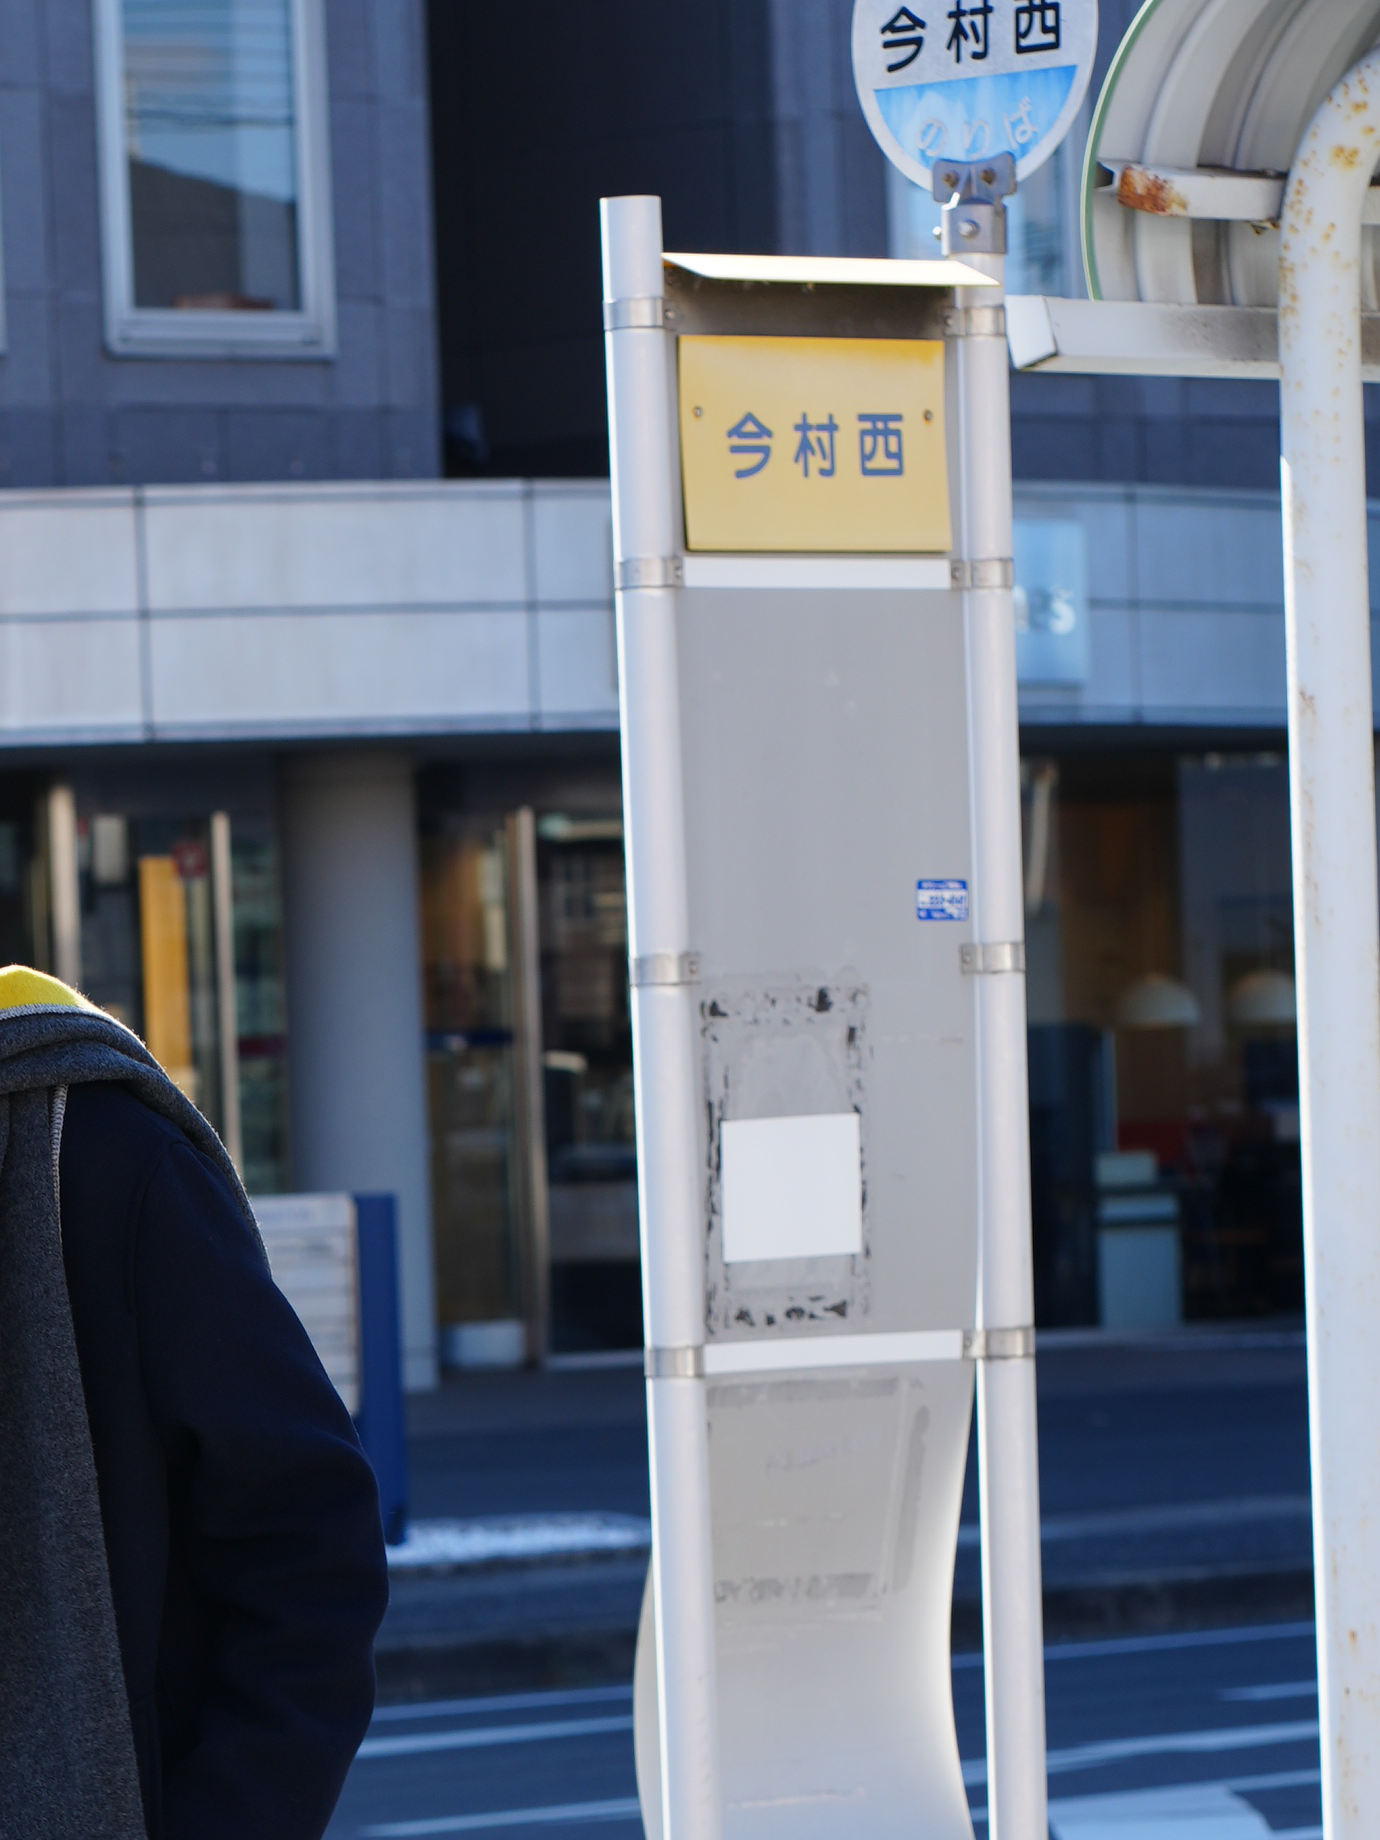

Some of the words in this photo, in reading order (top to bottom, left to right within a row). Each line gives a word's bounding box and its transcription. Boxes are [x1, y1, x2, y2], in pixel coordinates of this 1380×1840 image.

[880, 0, 1061, 73] 今村西
[917, 95, 1039, 160] のりば
[727, 412, 904, 479] 今村西
